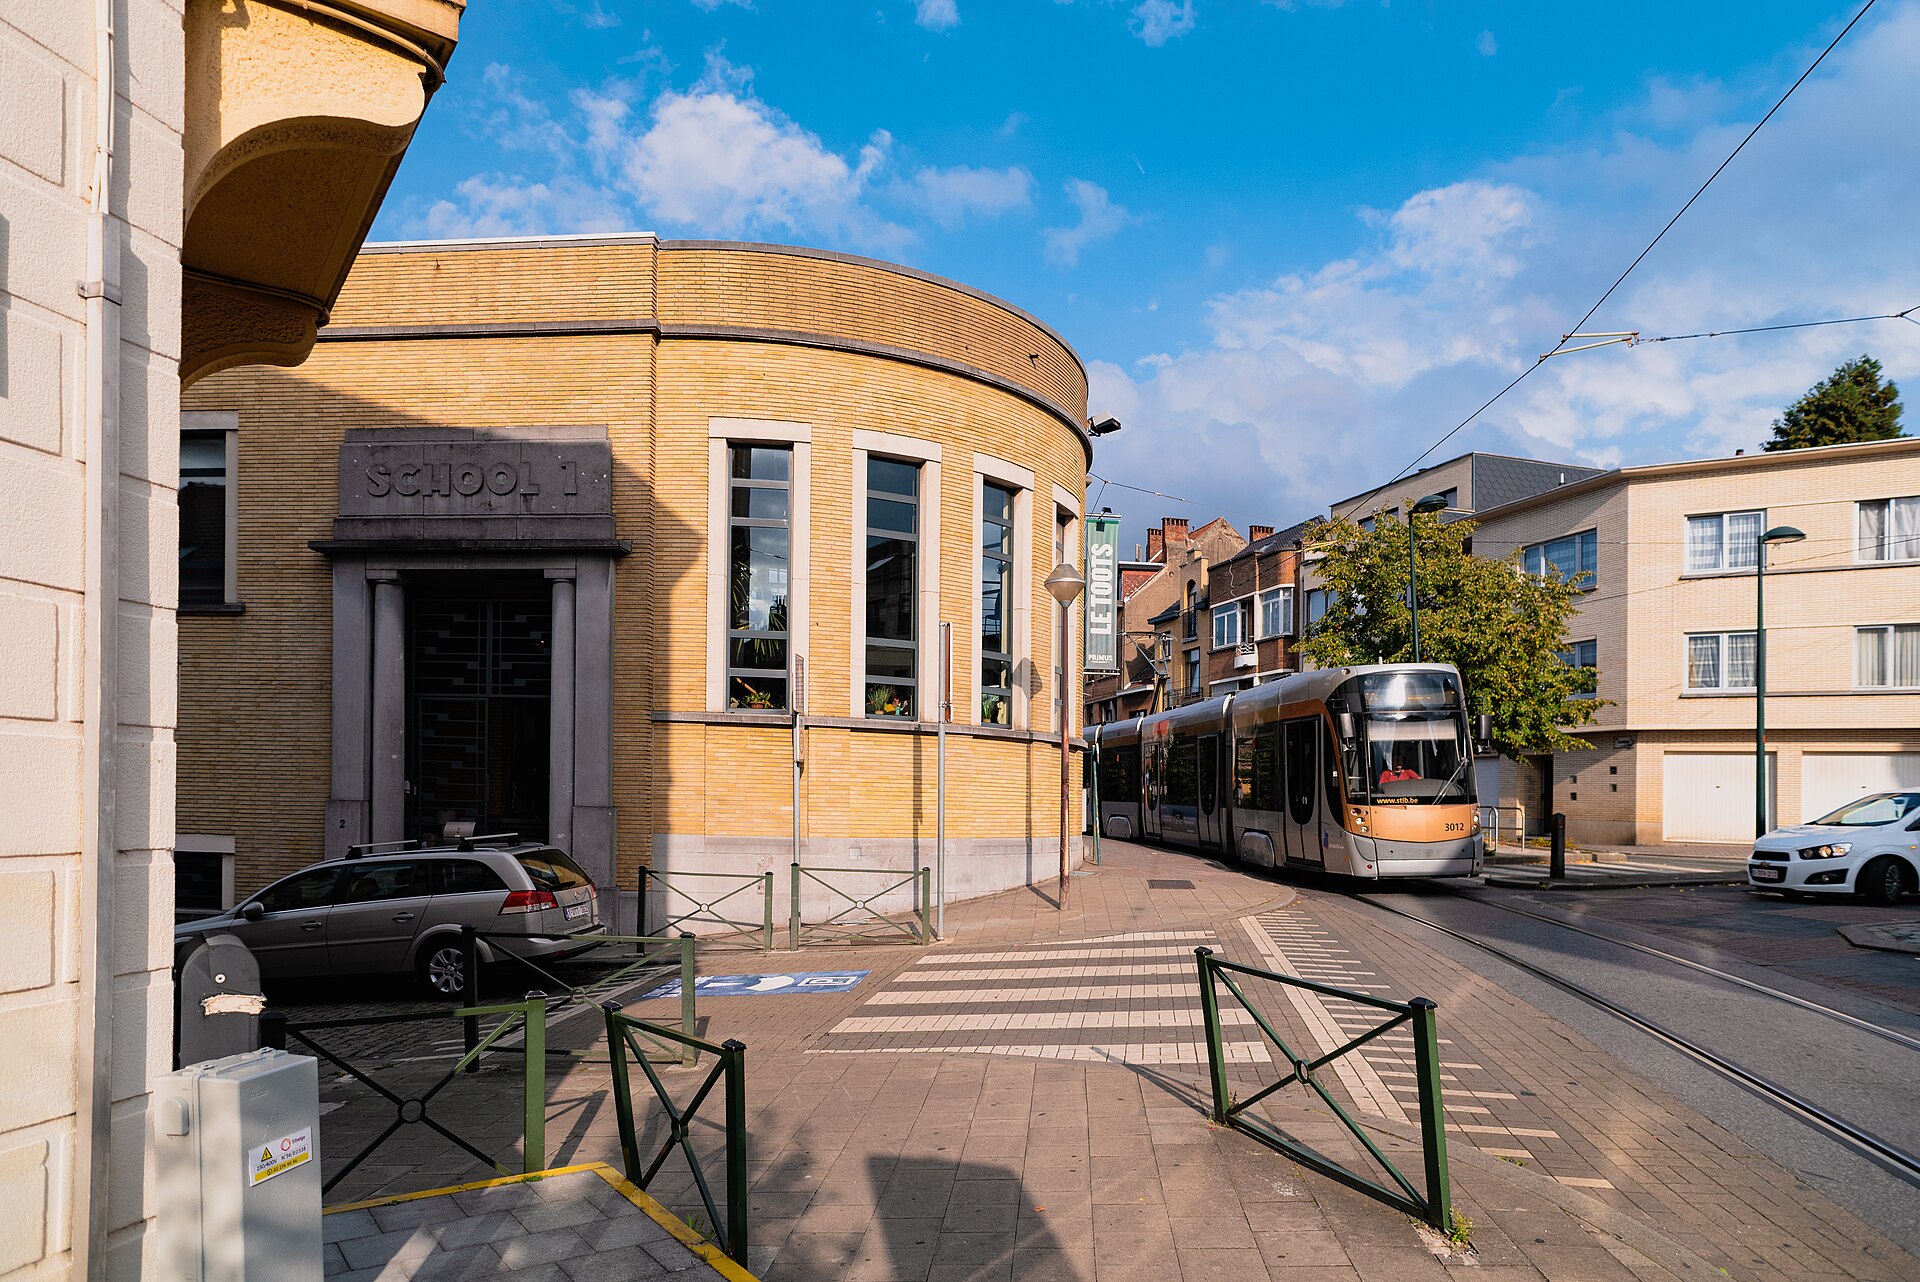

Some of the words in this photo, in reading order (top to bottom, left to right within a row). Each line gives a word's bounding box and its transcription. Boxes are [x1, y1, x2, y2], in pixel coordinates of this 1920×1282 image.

[367, 463, 539, 496] SCHOOL
[561, 461, 578, 496] 1
[1090, 543, 1113, 607] TOOTS
[1090, 611, 1112, 634] LE
[1088, 654, 1113, 662] PRIMUS
[339, 818, 346, 829] 2
[1445, 823, 1465, 831] 3012
[257, 1159, 278, 1171] 230/400V
